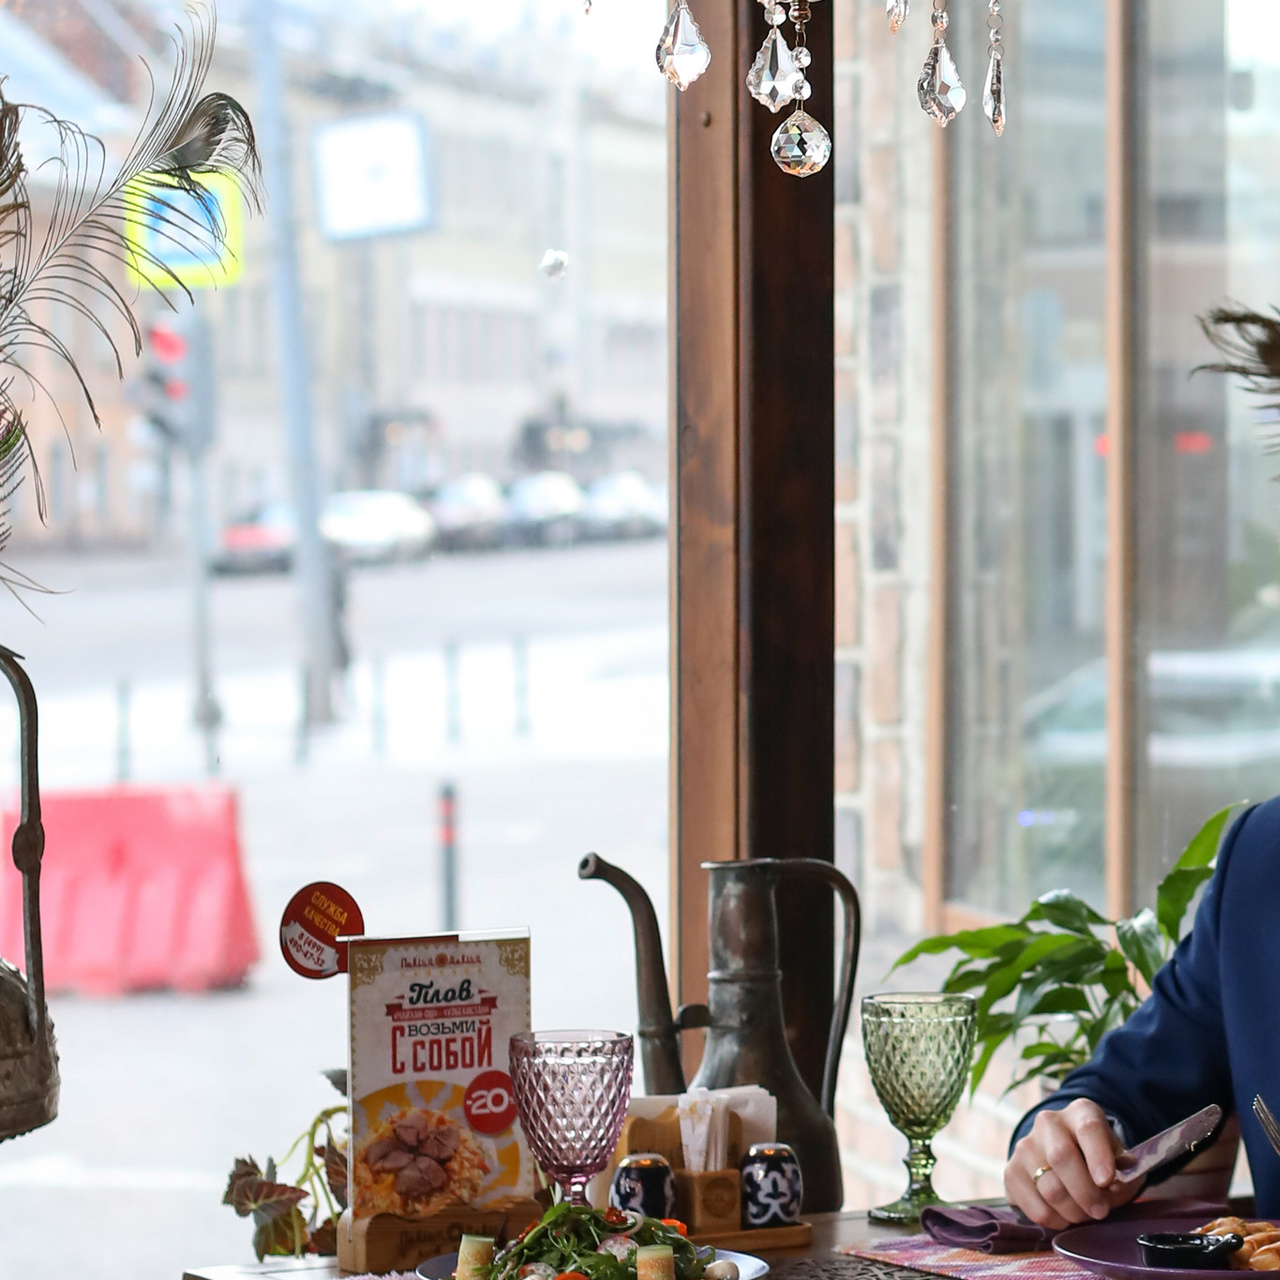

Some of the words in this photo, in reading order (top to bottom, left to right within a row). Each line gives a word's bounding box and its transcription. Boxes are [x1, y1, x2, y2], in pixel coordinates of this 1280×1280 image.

[303, 905, 340, 937] КАЧЕСТВА
[311, 891, 348, 925] СЛУЖБА
[303, 936, 324, 957] (499)
[408, 978, 474, 1005] Плов
[407, 1020, 477, 1037] ВОЗЬМИ
[392, 1025, 405, 1075] С
[412, 1019, 492, 1072] СОБОЙ
